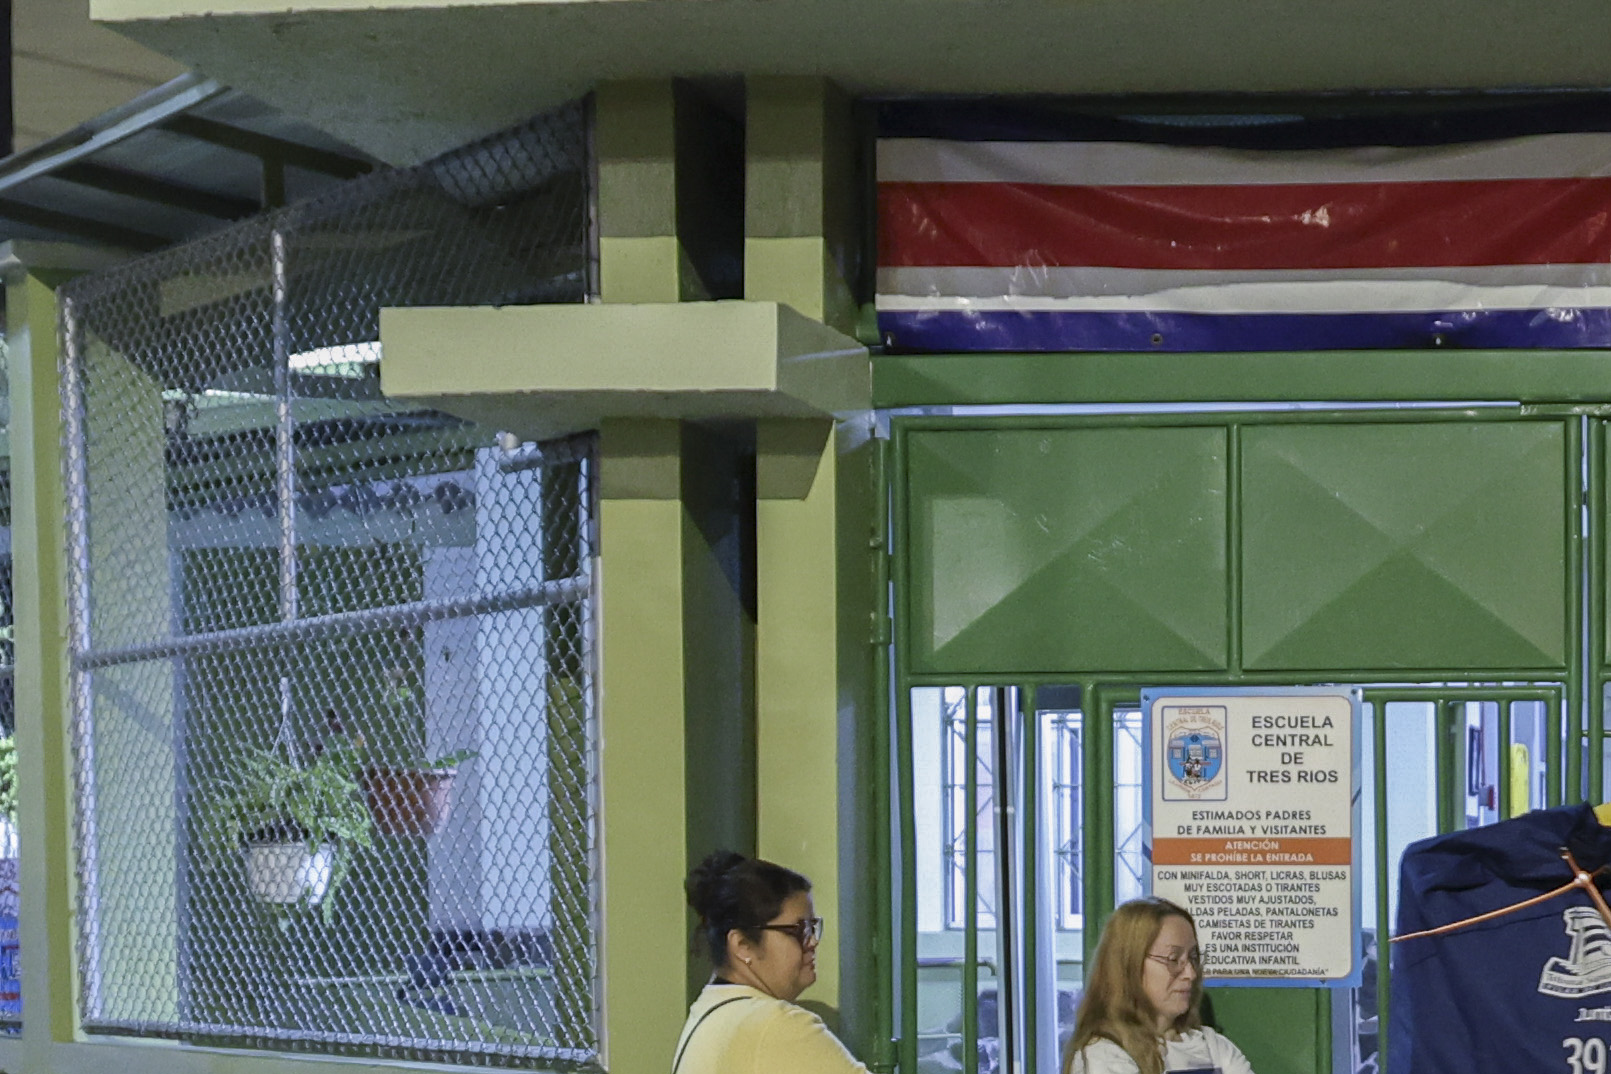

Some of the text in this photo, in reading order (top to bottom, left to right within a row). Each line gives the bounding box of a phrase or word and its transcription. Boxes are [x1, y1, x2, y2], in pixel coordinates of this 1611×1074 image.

[1251, 715, 1334, 729] ESCUELA
[1251, 733, 1334, 747] CENTRAL
[1280, 751, 1304, 765] DE
[1246, 769, 1339, 784] TRES RIOS
[1192, 810, 1311, 821] ESTIMADOS PADRES
[1177, 825, 1327, 835] DE FAMILIA Y VISITANTES
[1225, 839, 1279, 850] ATENCIÓN
[1190, 850, 1314, 863] SE PROHÍBE LA ENTRADA
[1157, 870, 1178, 880] CON
[1234, 870, 1269, 882] SHORT,
[1270, 870, 1307, 882] LICRAS,
[1309, 870, 1347, 880] BLUSAS
[1184, 883, 1320, 893] MUY ESCOTADAS O TIRANTES
[1188, 895, 1317, 906] VESTIDOS MUY AJUSTADOS,
[1217, 907, 1263, 918] PELADAS,
[1265, 907, 1338, 917] PANTALONETAS
[1198, 919, 1251, 929] CAMISETAS
[1254, 919, 1266, 929] DE
[1269, 919, 1314, 929] TIRANTES
[1211, 931, 1293, 941] FAVOR RESPETAR
[1205, 941, 1300, 953] ES UNA INSTITUCIÓN
[1205, 955, 1299, 965] EDUCATIVA INFANTIL
[1212, 968, 1232, 976] PARA
